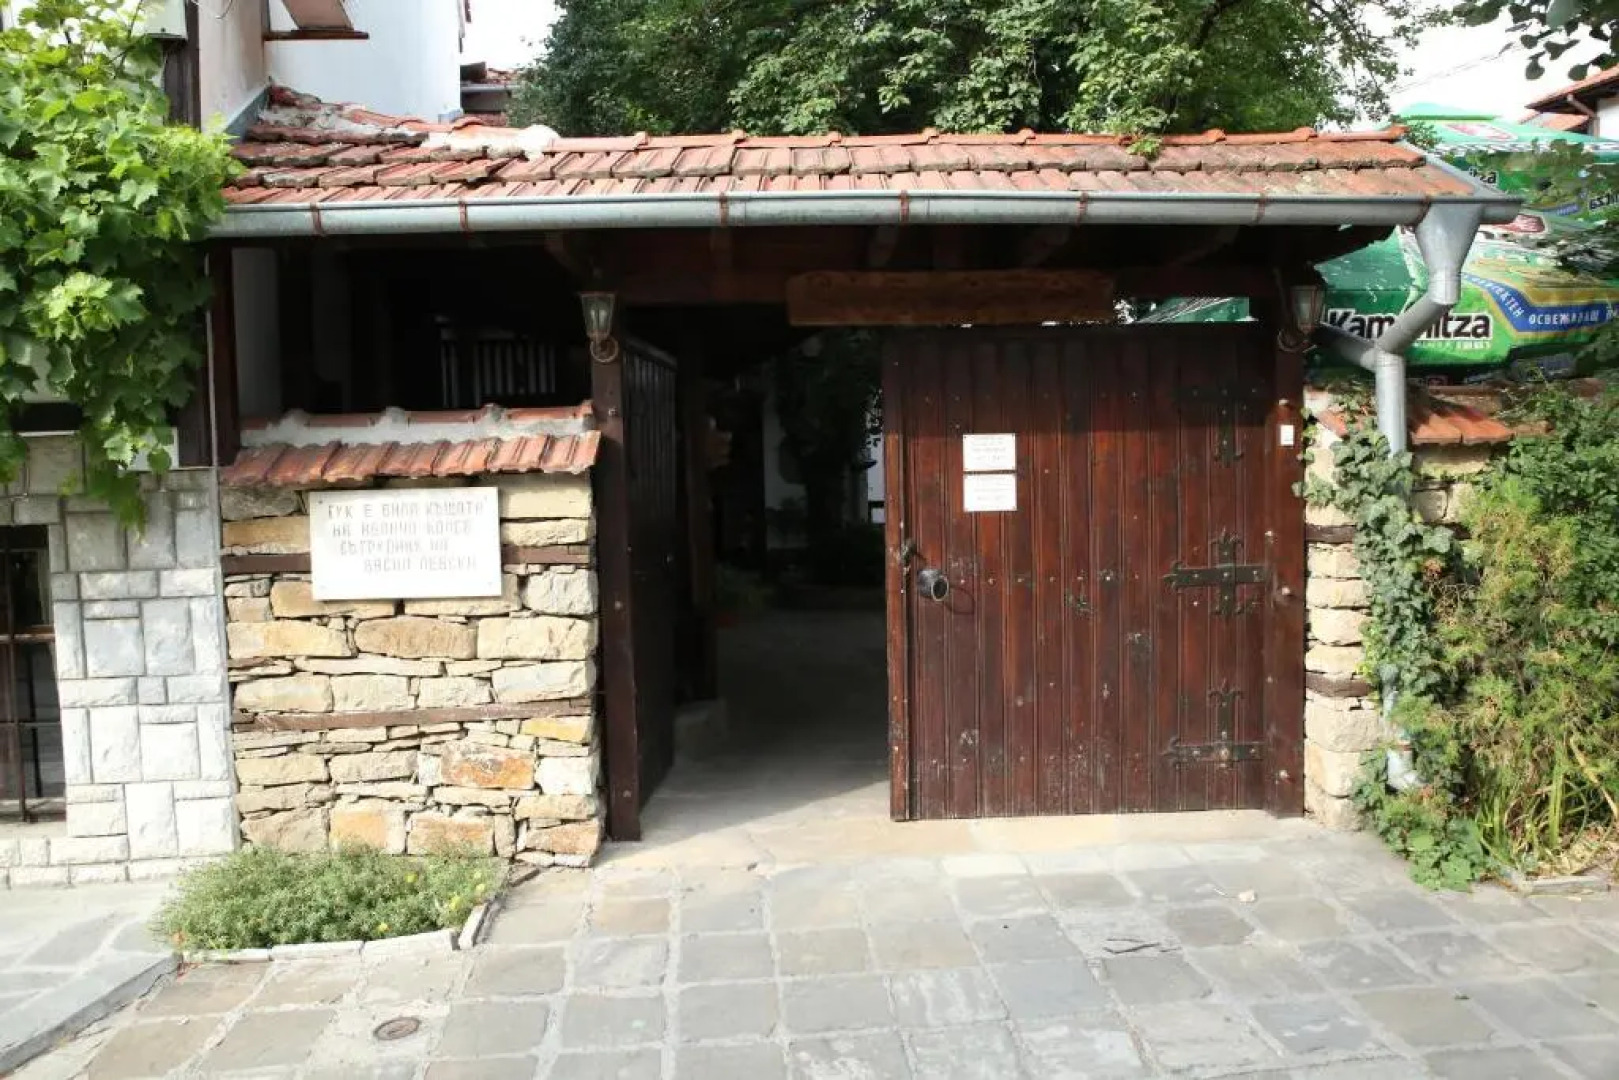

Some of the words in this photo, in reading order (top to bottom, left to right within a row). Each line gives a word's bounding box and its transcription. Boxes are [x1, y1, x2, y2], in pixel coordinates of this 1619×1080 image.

[1329, 310, 1492, 340] Kamitza
[327, 505, 353, 519] ТУК
[364, 504, 373, 517] Е
[382, 502, 419, 517] БИЛА
[332, 524, 351, 537] НА
[429, 537, 449, 551] НА
[364, 557, 411, 573] ВАСИЛ
[419, 555, 477, 571] ЛЕВСКИ
